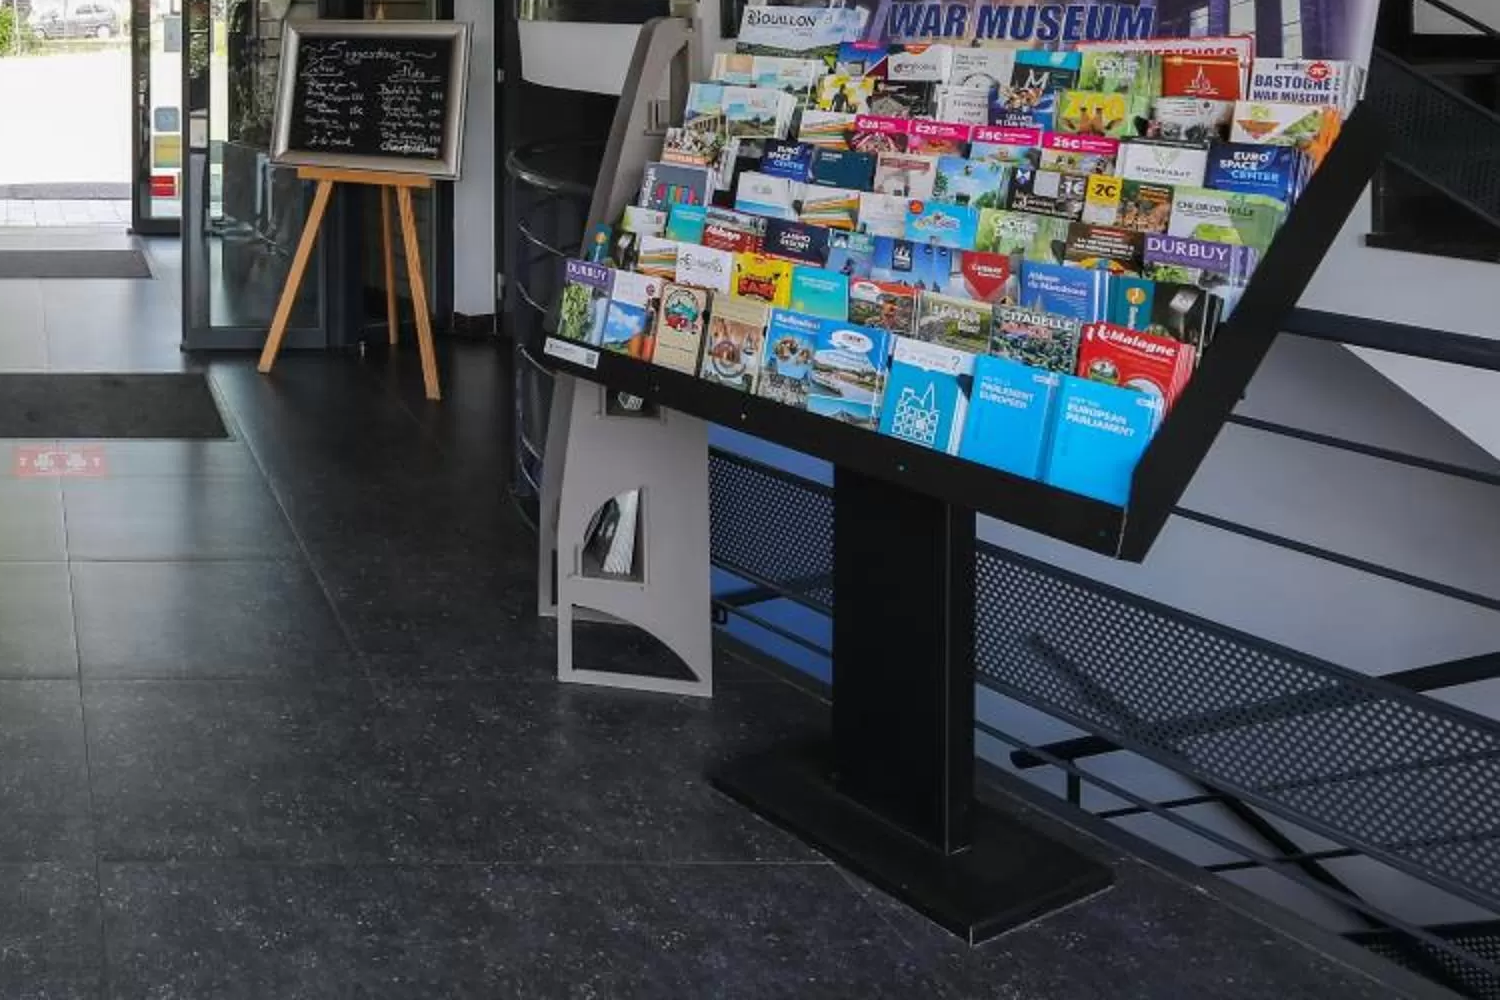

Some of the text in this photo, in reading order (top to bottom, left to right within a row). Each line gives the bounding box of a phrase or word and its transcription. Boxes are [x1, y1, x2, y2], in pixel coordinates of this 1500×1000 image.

[747, 9, 816, 27] BOUILLON
[888, 3, 1156, 41] WAR MUSEUM
[1253, 90, 1329, 104] WAR MUSEUM
[1219, 159, 1258, 170] SPACE
[1233, 151, 1270, 162] EURO
[1230, 170, 1280, 182] CENTER
[1147, 237, 1229, 261] DURBUY
[567, 261, 608, 281] DURBUY
[1002, 310, 1074, 330] CITADELLE
[1067, 402, 1128, 425] EUROPEAN
[1066, 411, 1136, 437] PARLIAMENT
